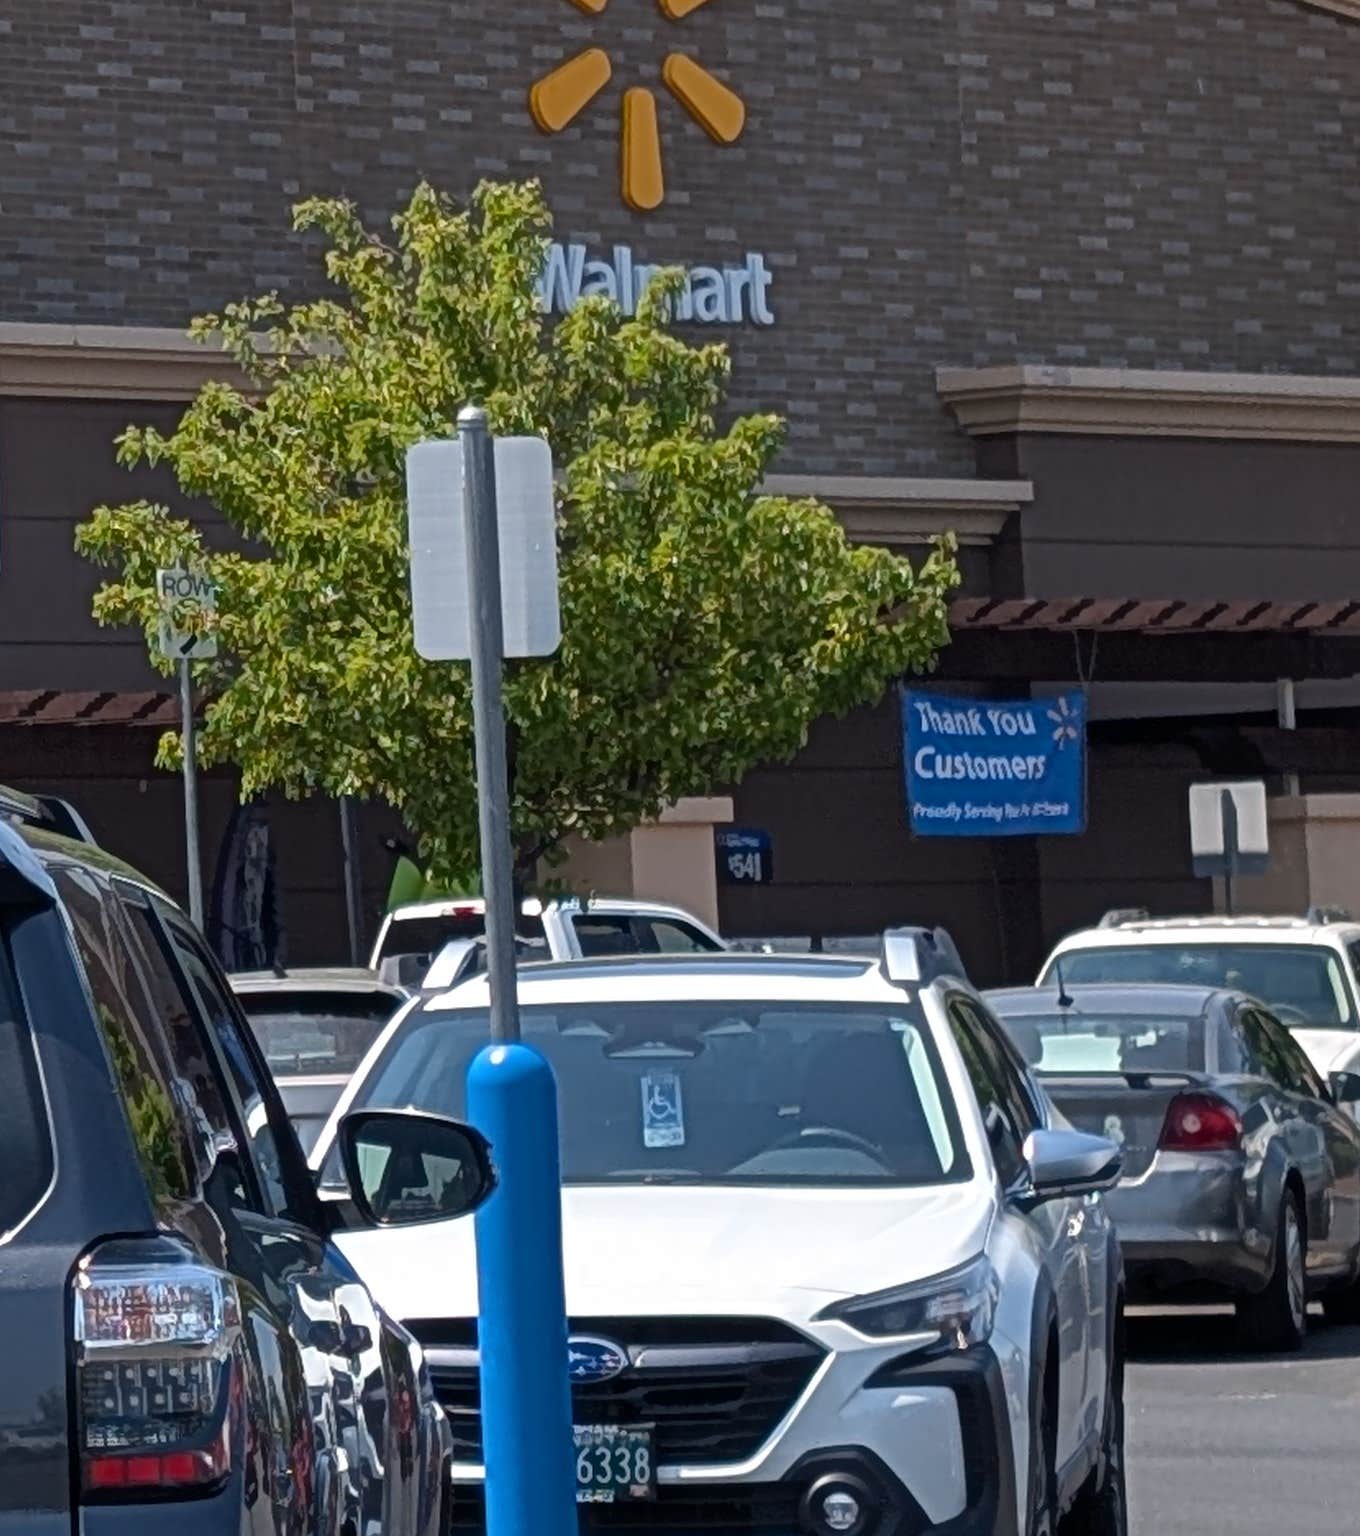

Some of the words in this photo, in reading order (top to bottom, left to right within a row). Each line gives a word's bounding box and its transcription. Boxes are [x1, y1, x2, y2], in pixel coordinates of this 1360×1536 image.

[913, 702, 986, 736] Thank
[988, 709, 1037, 736] You
[915, 746, 1046, 780] Customers
[913, 802, 962, 822] Proudly
[964, 802, 1003, 822] Serving
[577, 1447, 650, 1483] 6338
